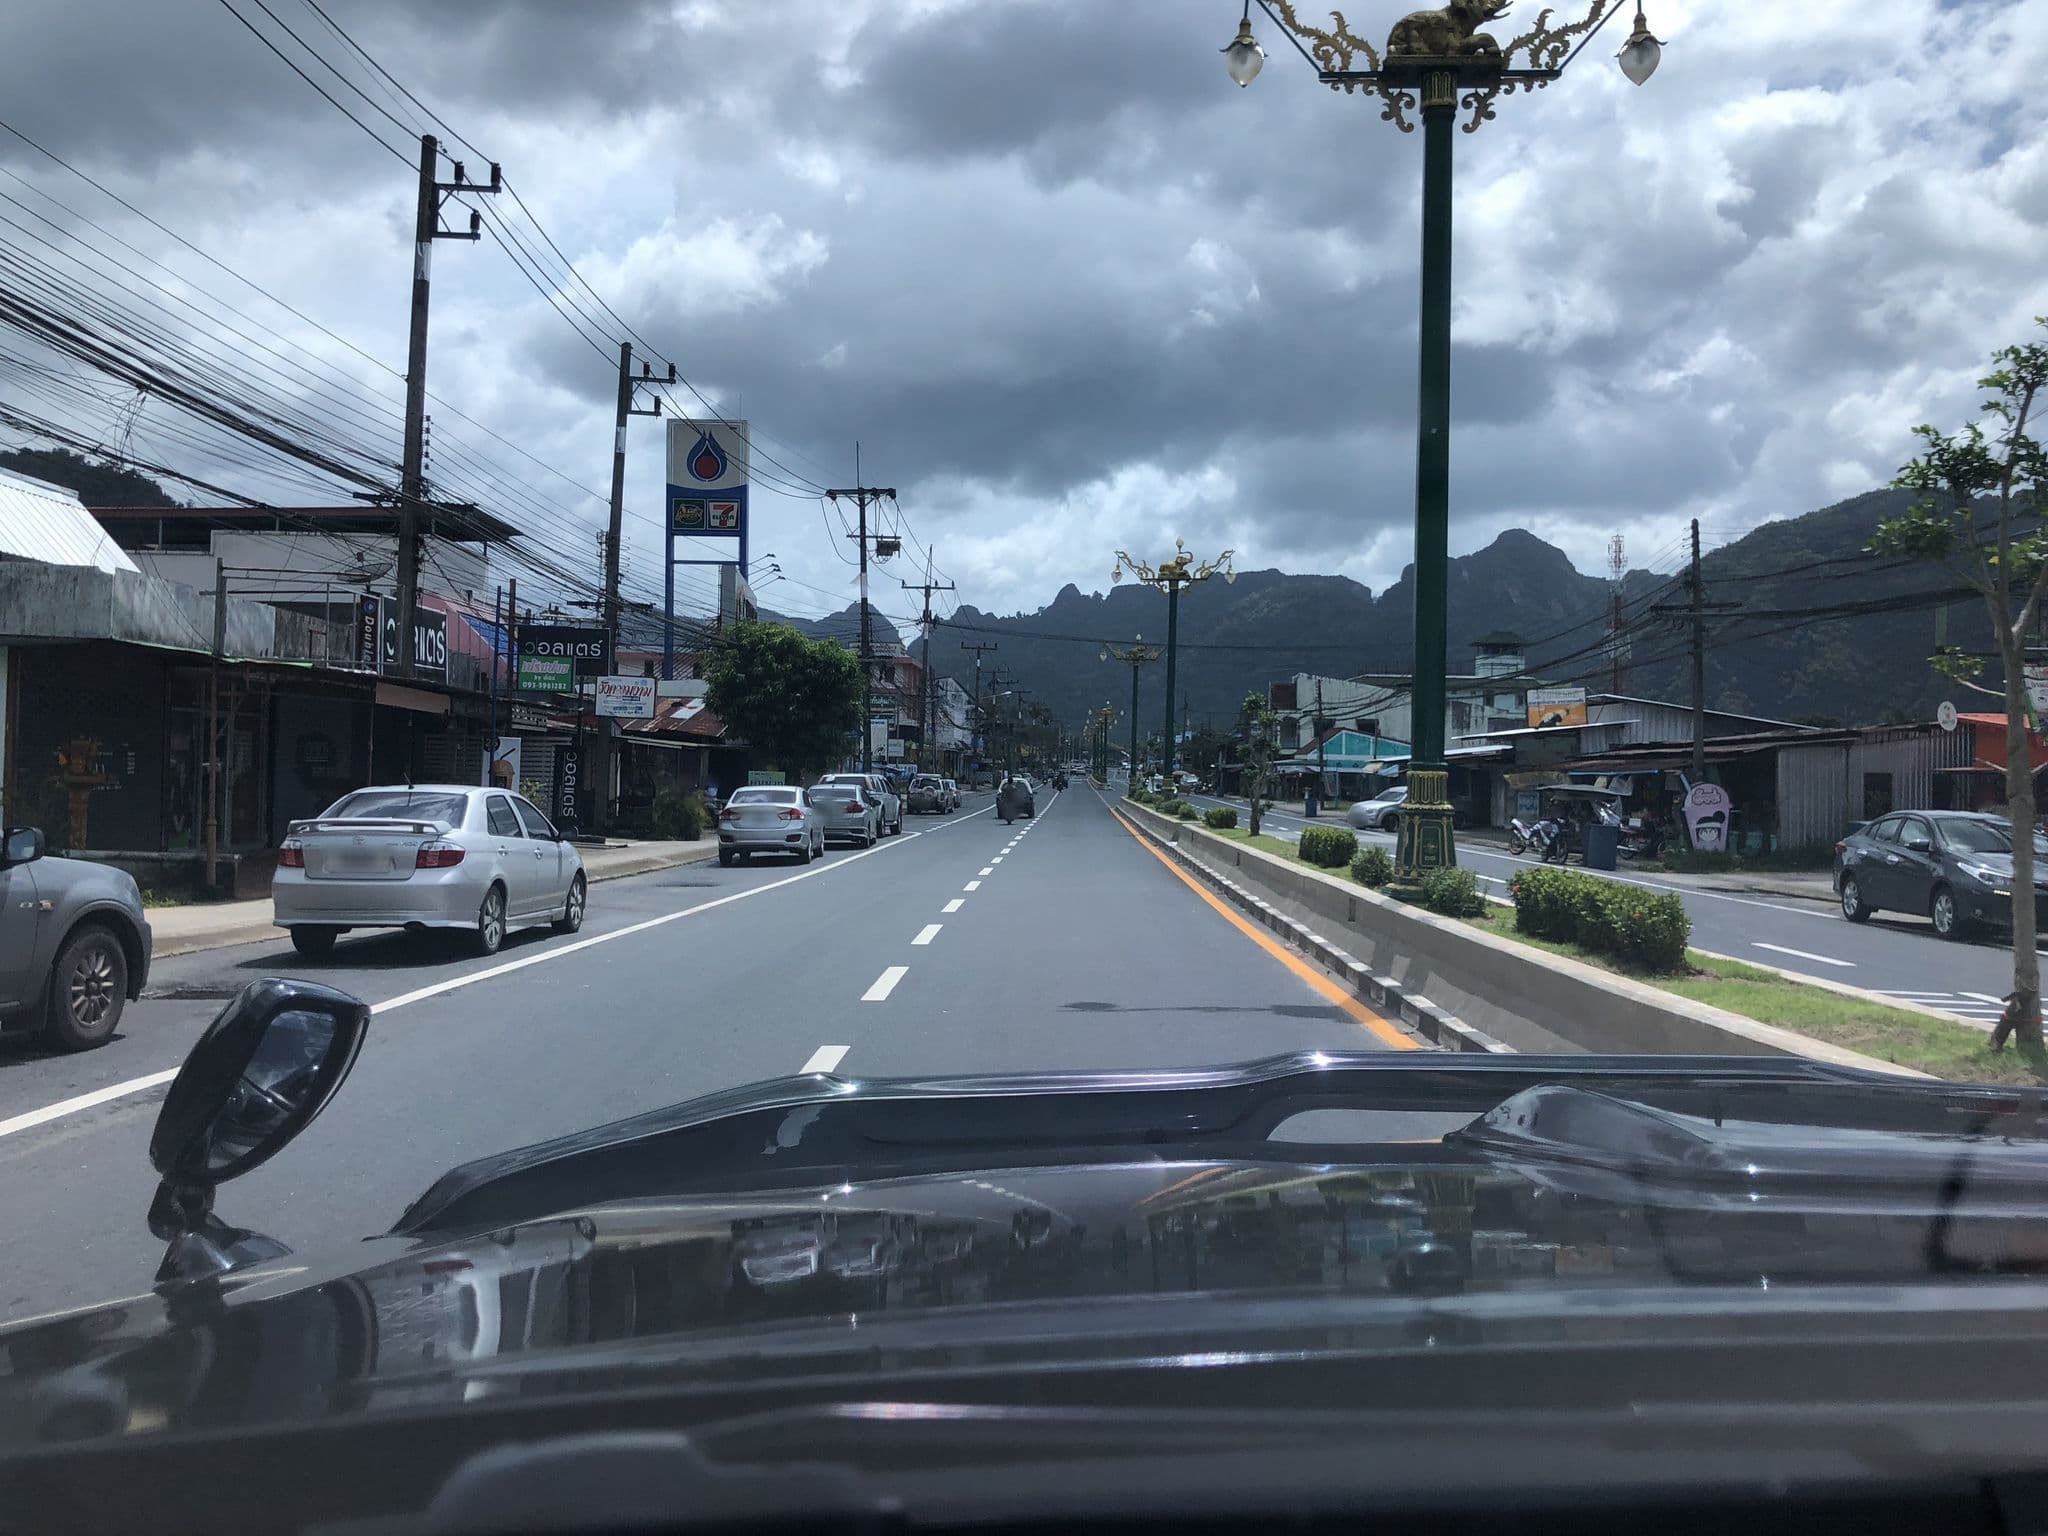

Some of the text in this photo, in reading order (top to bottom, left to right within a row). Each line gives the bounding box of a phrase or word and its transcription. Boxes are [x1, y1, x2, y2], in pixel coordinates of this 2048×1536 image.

[525, 640, 603, 656] วอลแตร์
[563, 752, 577, 818] วอลแตร์
